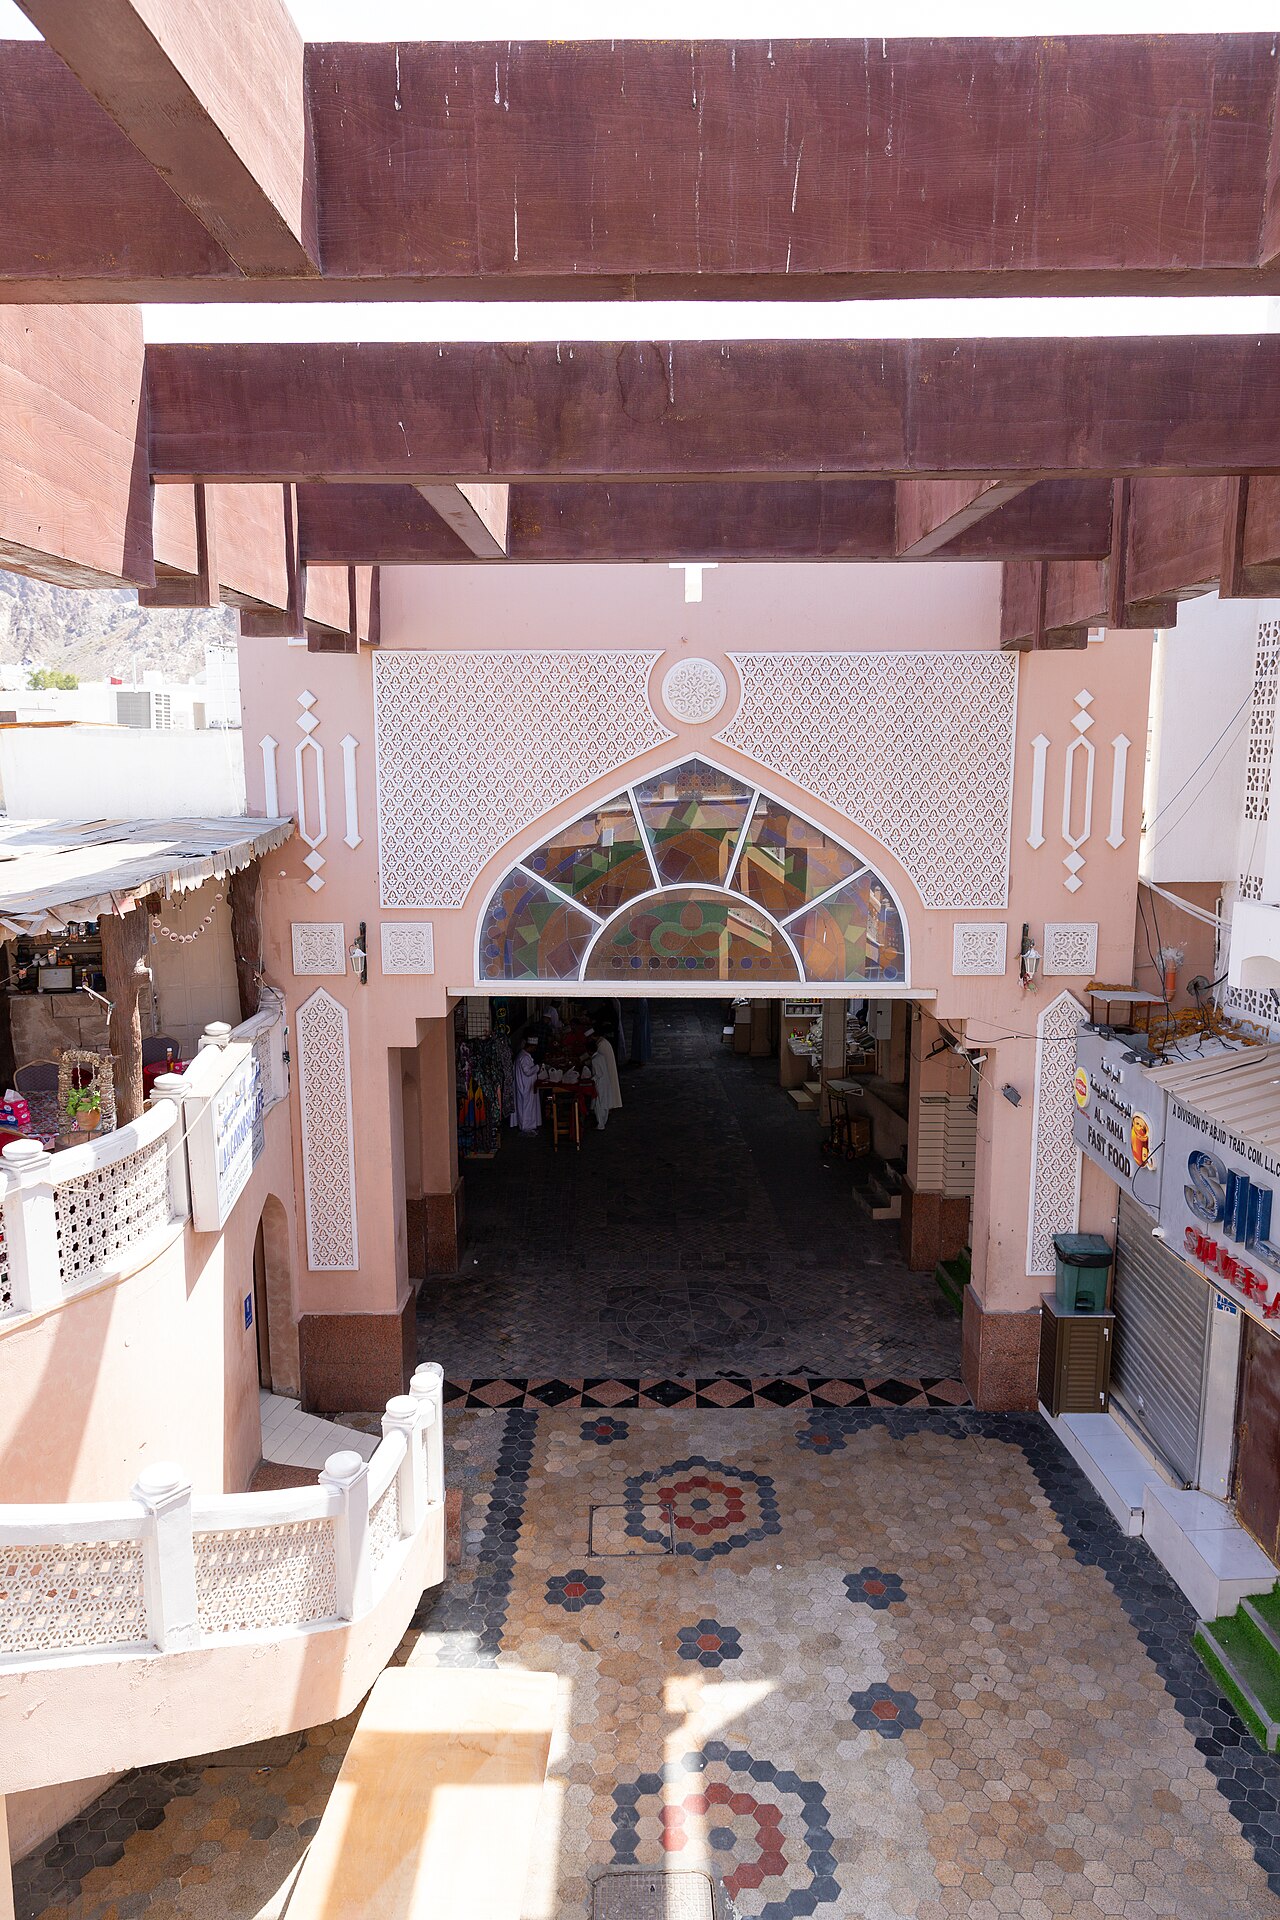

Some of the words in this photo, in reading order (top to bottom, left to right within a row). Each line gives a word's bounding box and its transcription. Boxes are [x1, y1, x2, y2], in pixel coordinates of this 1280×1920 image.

[1087, 1125, 1107, 1157] FAST
[1108, 1144, 1131, 1178] FOOD
[1172, 1104, 1177, 1117] A
[1177, 1106, 1200, 1130] DIVISION
[1201, 1119, 1209, 1135] OF
[1228, 1134, 1246, 1158] TRAD.
[1247, 1146, 1263, 1168] COM.
[1183, 1226, 1268, 1307] SILVER
